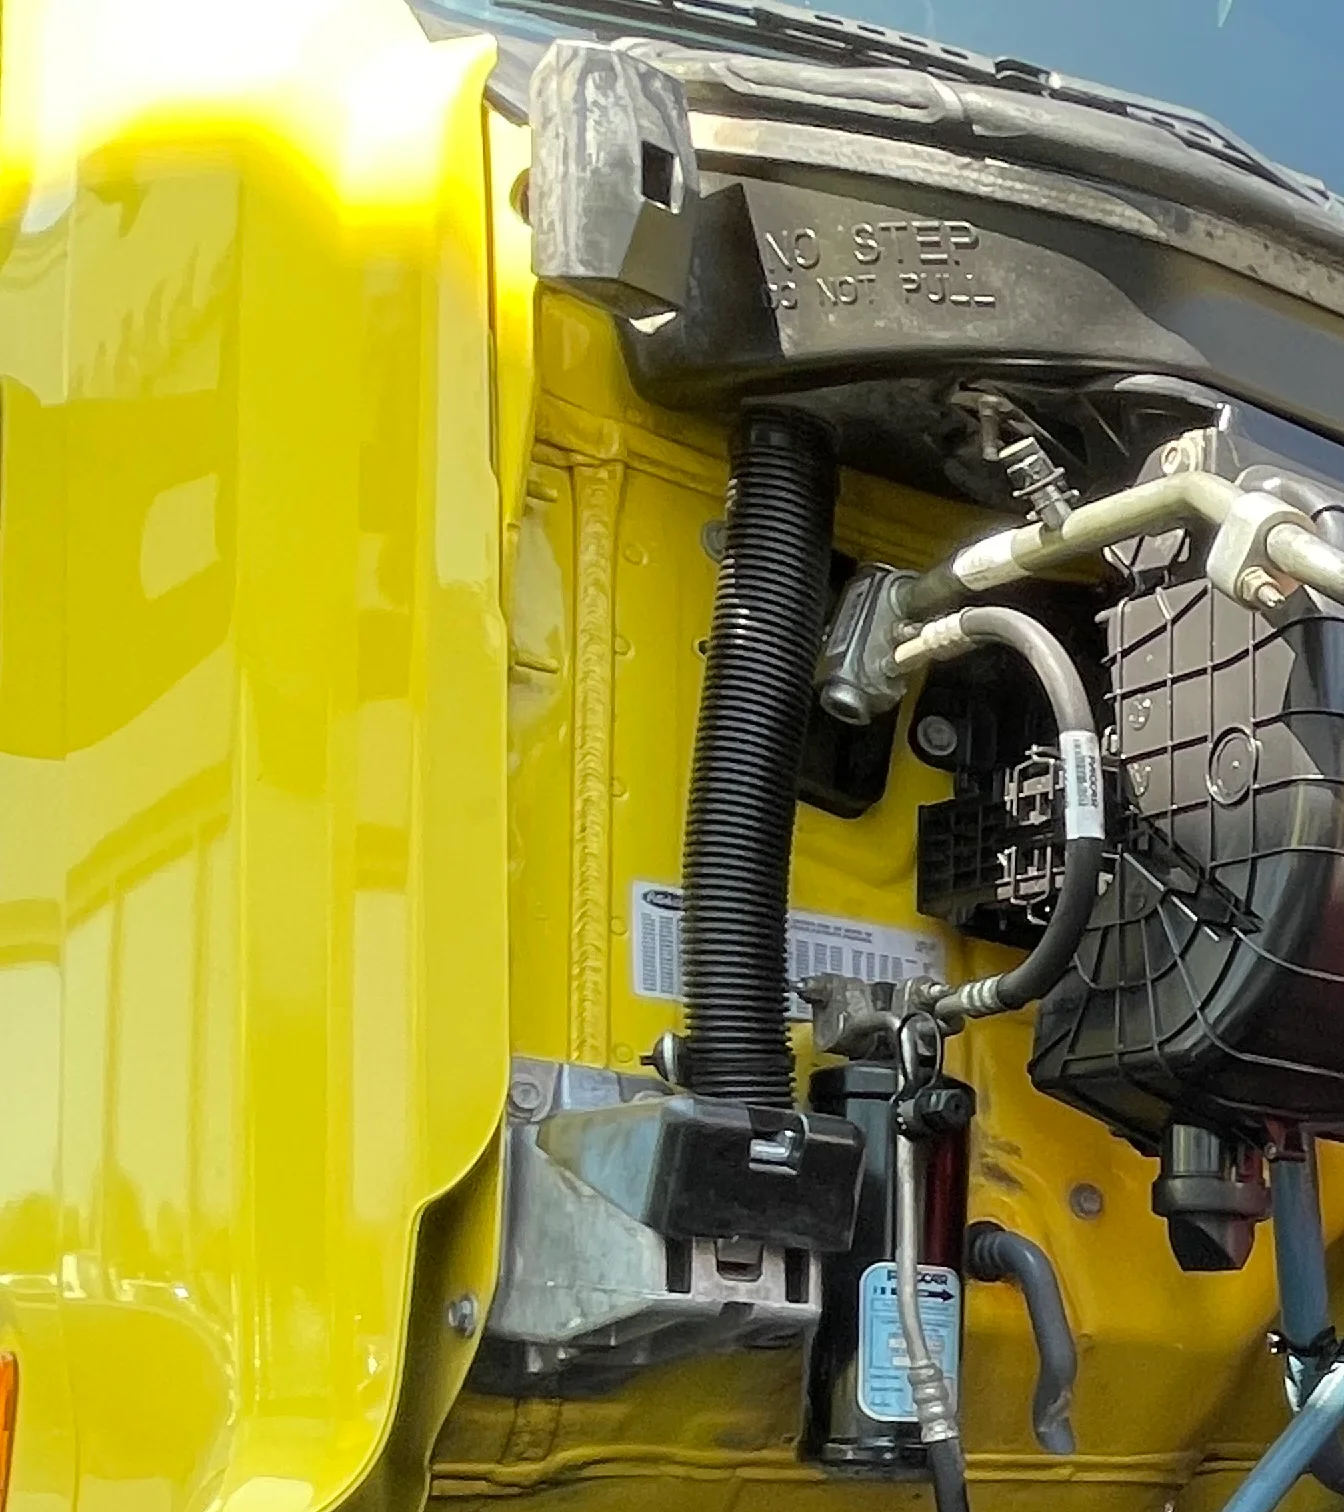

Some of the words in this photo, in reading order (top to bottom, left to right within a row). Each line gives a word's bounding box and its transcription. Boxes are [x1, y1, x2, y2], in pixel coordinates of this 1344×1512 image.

[764, 228, 820, 271] NO
[852, 220, 979, 264] STEP
[816, 276, 876, 306] NOT
[899, 273, 996, 307] PULL
